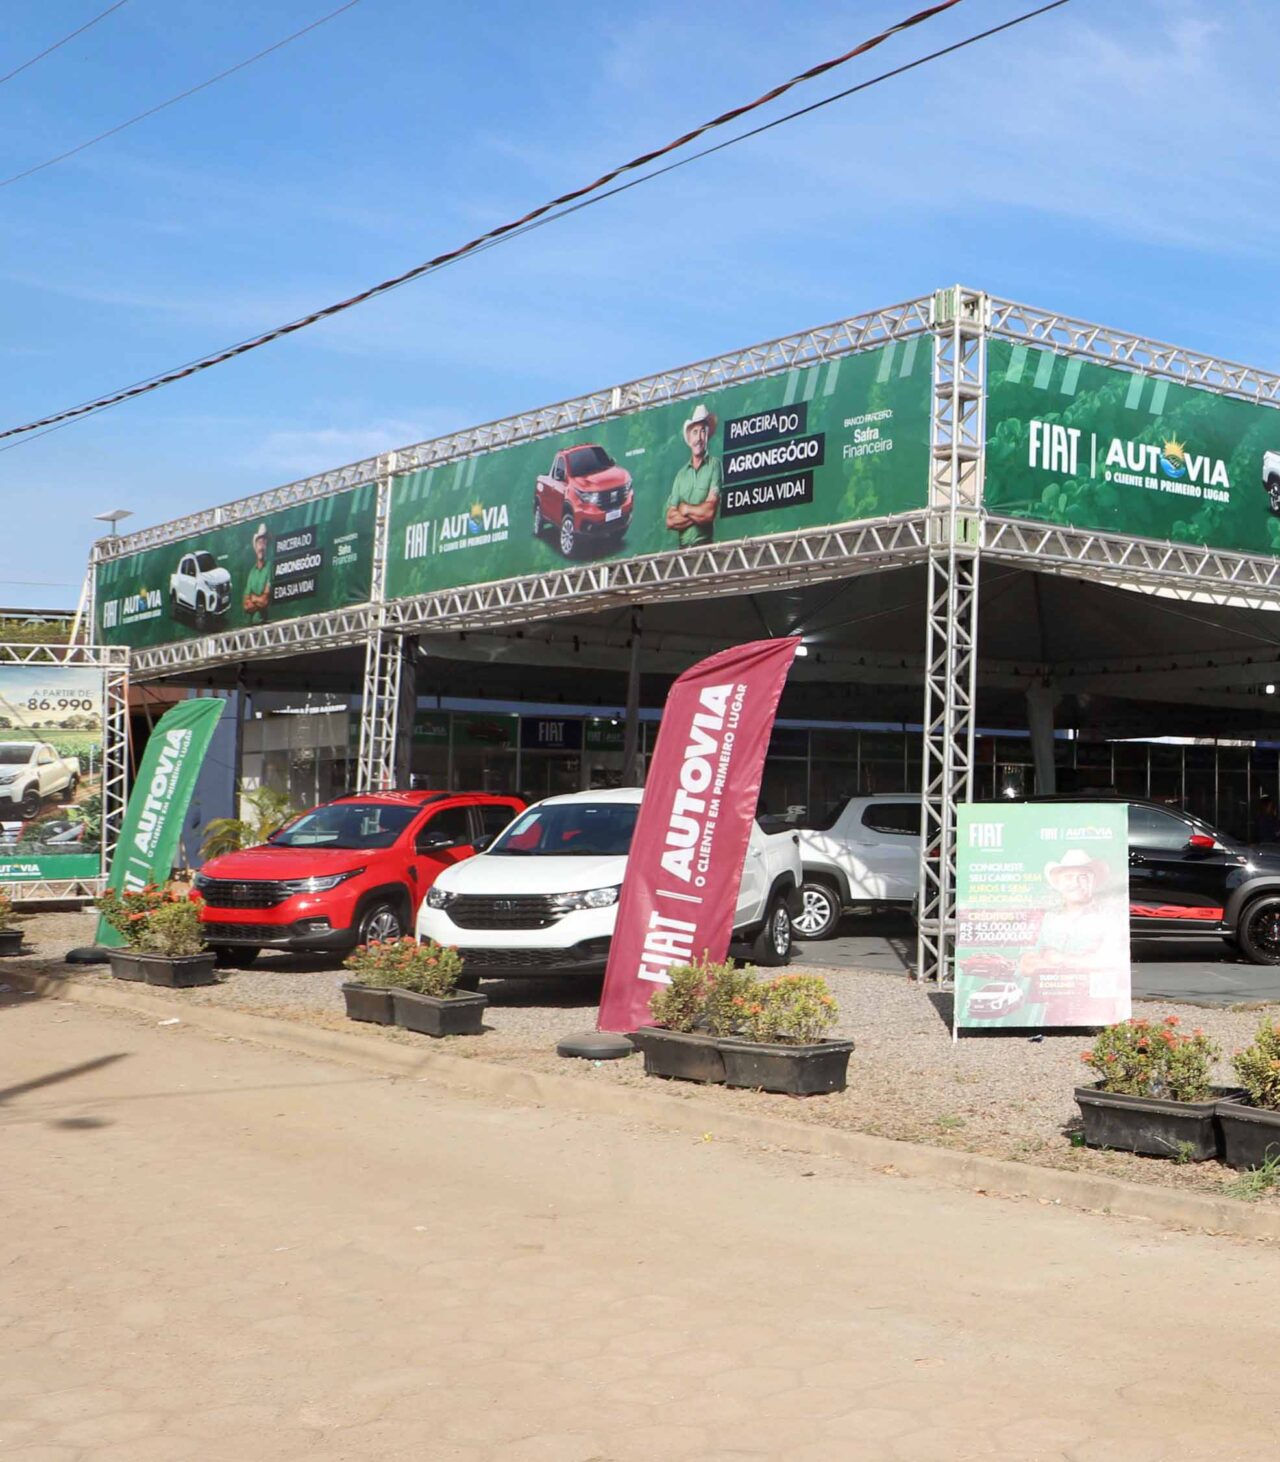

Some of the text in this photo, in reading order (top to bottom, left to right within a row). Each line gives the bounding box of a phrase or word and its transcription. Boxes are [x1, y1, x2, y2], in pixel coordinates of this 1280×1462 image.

[730, 413, 798, 439] PARCEIRA DO
[854, 427, 879, 443] Safra
[728, 440, 818, 474] AGRONEGÓCIO
[843, 438, 893, 459] Financeira
[1028, 419, 1081, 476] FIAT
[1105, 436, 1230, 488] AUTOVIA
[727, 479, 805, 508] E DA SUA VIDA!
[1105, 470, 1230, 503] O CLIENTE EM PRIMEIRO LUGAR
[440, 504, 509, 541] AUTOVIA
[404, 521, 430, 560] FIAT
[28, 698, 92, 711] 86.990
[538, 722, 566, 742] FIAT
[134, 729, 188, 854] AUTOVIA
[660, 683, 734, 882] AUTOVIA
[694, 684, 748, 887] O CLIENTE EM PRIMEIRO LUGAR
[969, 823, 1004, 848] FIAT
[0, 864, 40, 872] UTOVIA
[988, 873, 1022, 882] CARRO
[637, 910, 697, 985] FIAT
